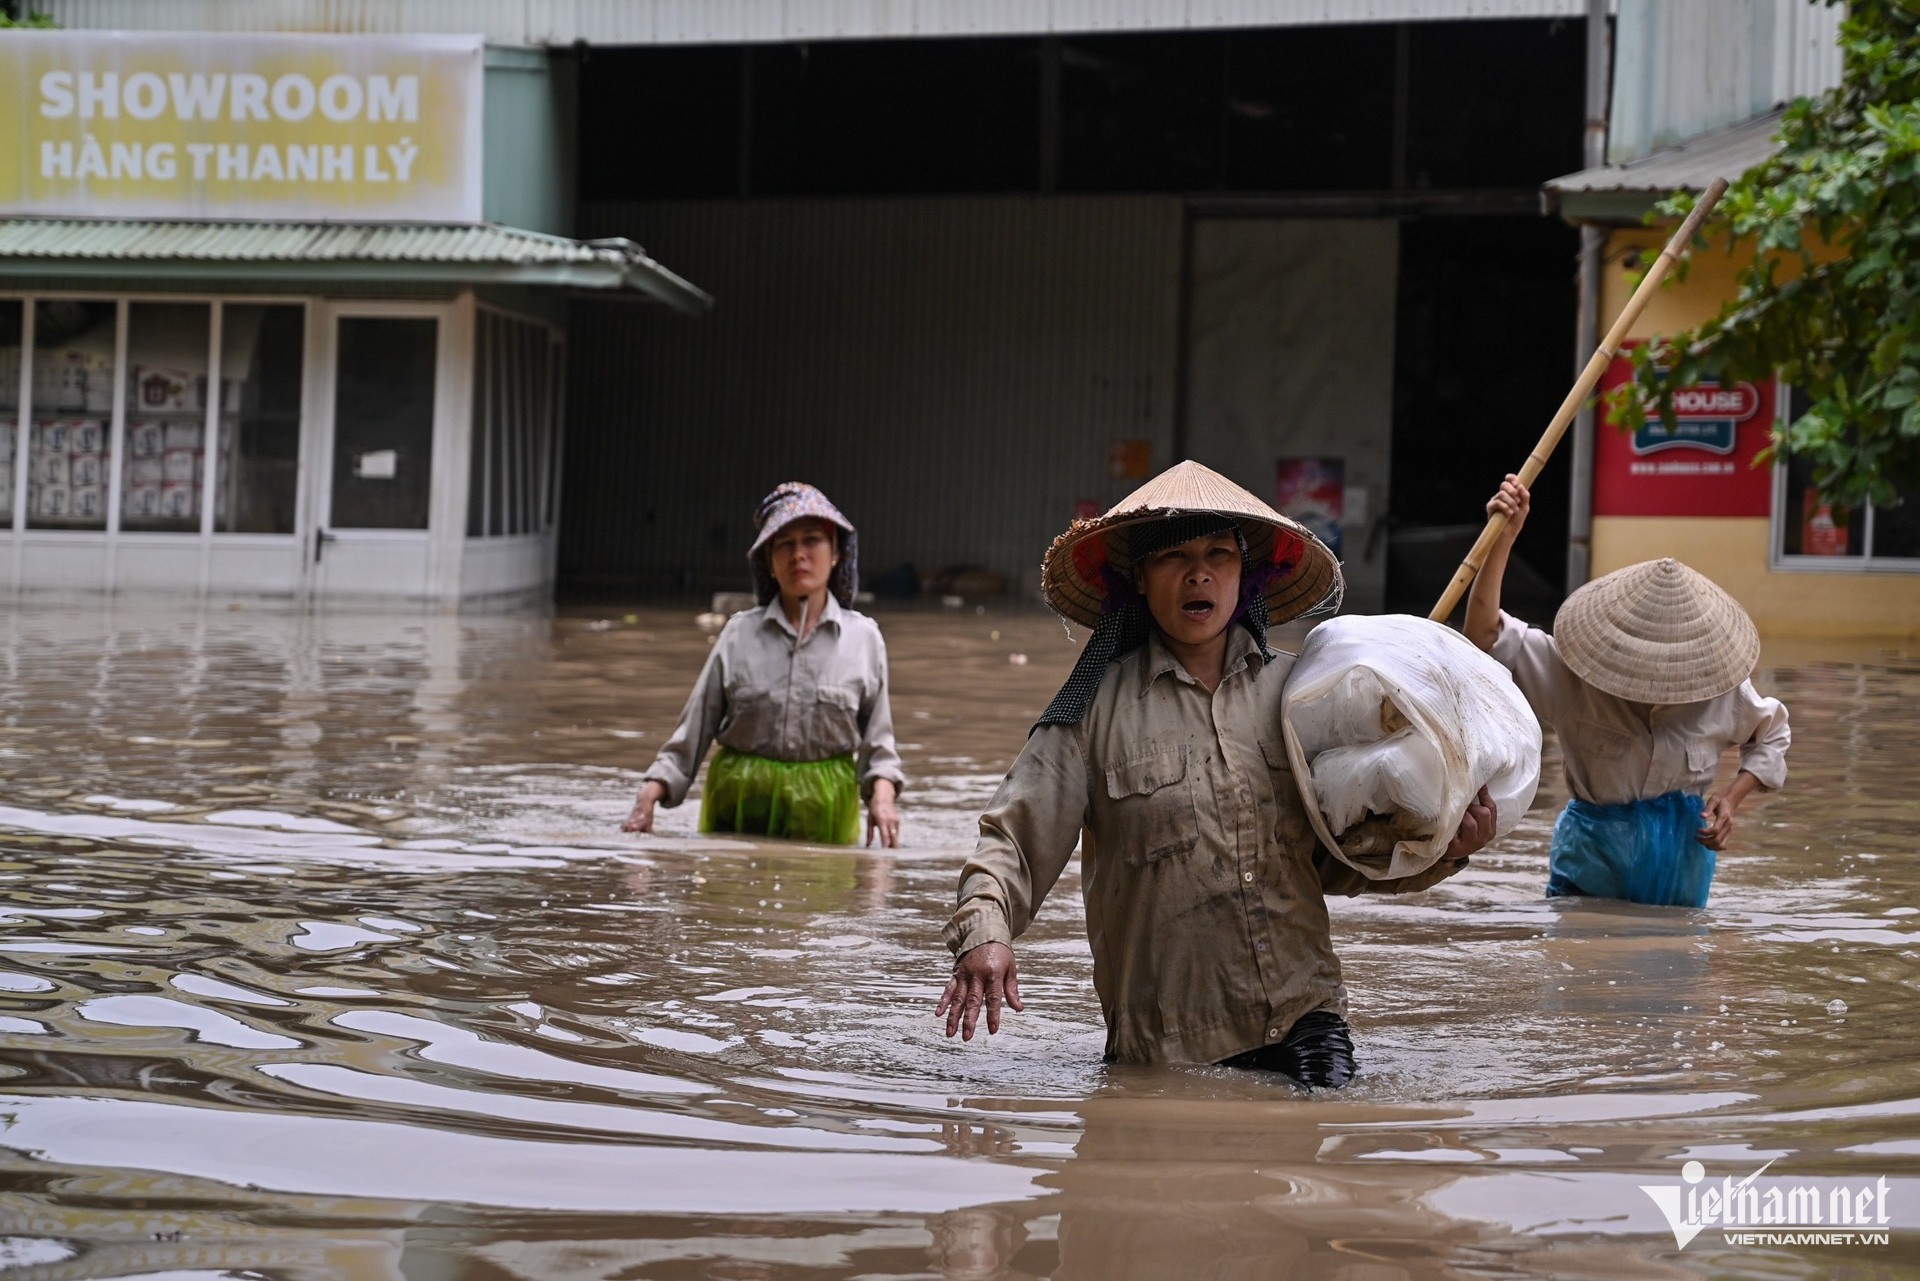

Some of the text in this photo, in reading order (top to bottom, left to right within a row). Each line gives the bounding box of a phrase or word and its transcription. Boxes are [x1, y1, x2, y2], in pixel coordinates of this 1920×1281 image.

[40, 71, 418, 121] SHOWROOM
[41, 136, 418, 182] HÀNG THANH LÝ
